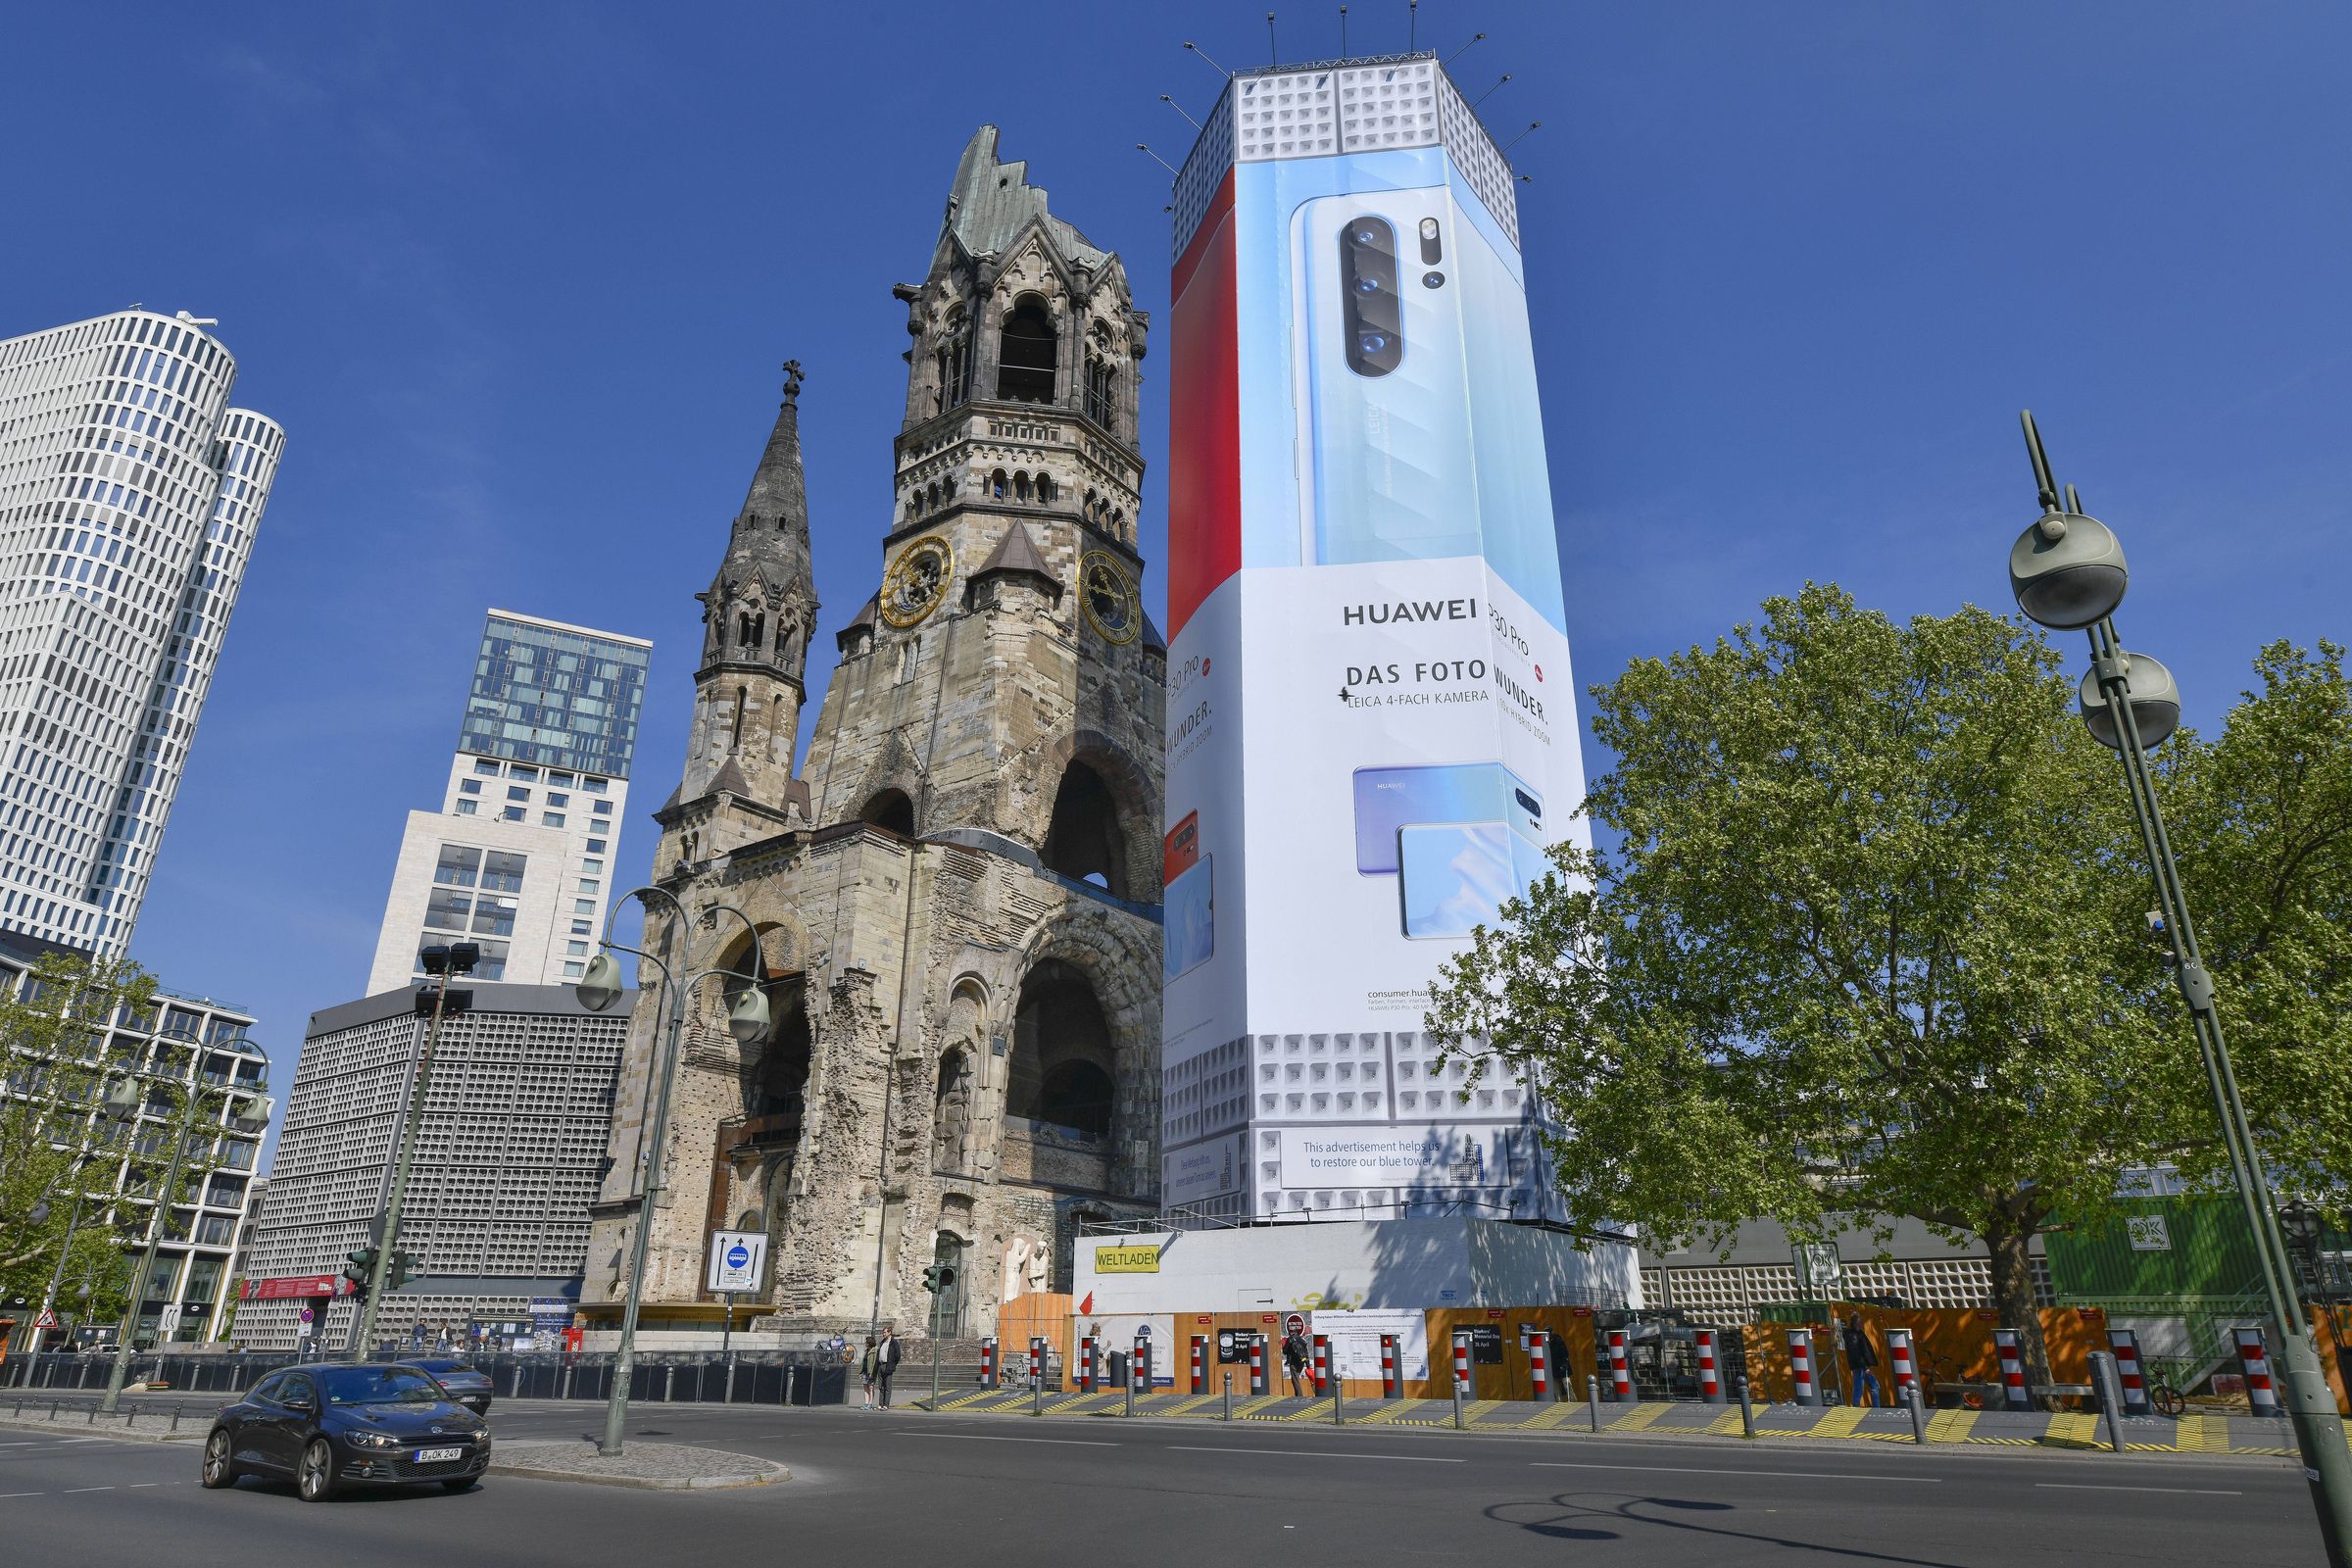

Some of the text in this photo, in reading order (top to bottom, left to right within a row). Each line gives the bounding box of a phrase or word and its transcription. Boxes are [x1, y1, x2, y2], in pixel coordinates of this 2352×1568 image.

[1344, 598, 1477, 626] HUAWEI
[1510, 624, 1529, 656] Pro
[1184, 655, 1200, 682] Pro
[1347, 660, 1486, 686] DAS FOTO
[1348, 690, 1490, 709] LEICA 4-FACH KAMERA
[1493, 663, 1548, 725] WUNDER.
[1166, 700, 1212, 757] WUNDER.
[1196, 724, 1212, 748] ZOOM
[1510, 707, 1532, 732] HYBRID
[1533, 725, 1551, 747] ZOOM
[1303, 1140, 1440, 1154] This advertisement helps us
[1310, 1155, 1435, 1168] to restore our blue tower.
[1098, 1252, 1158, 1265] WELTLADEN
[421, 1450, 427, 1459] B
[444, 1449, 459, 1458] 249
